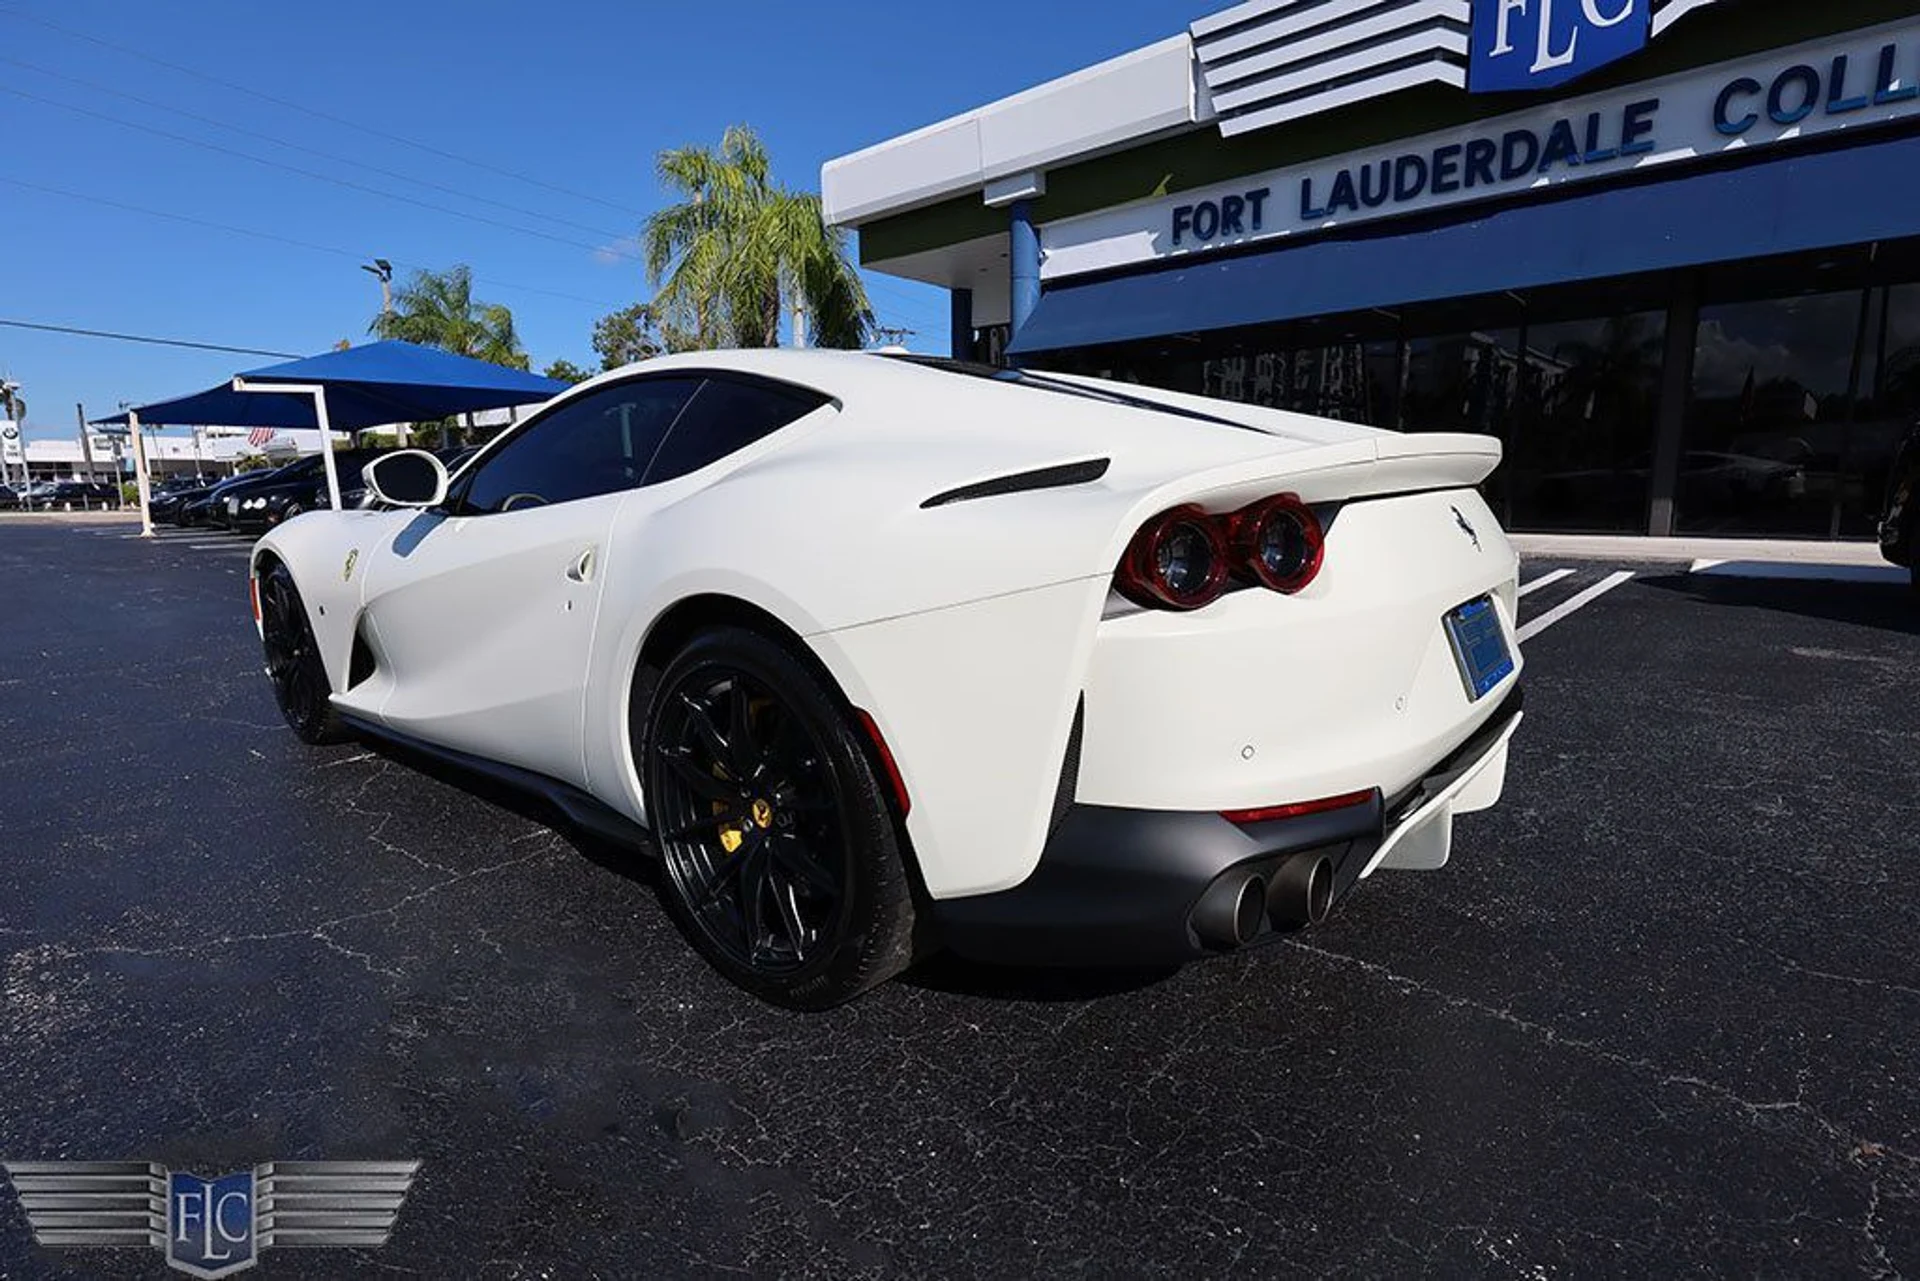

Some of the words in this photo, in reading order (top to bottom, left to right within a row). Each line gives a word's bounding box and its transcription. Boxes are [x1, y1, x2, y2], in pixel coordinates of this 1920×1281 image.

[1171, 187, 1270, 245] FORT
[1300, 98, 1660, 220] LAUDERDALE
[1713, 43, 1918, 135] COLL
